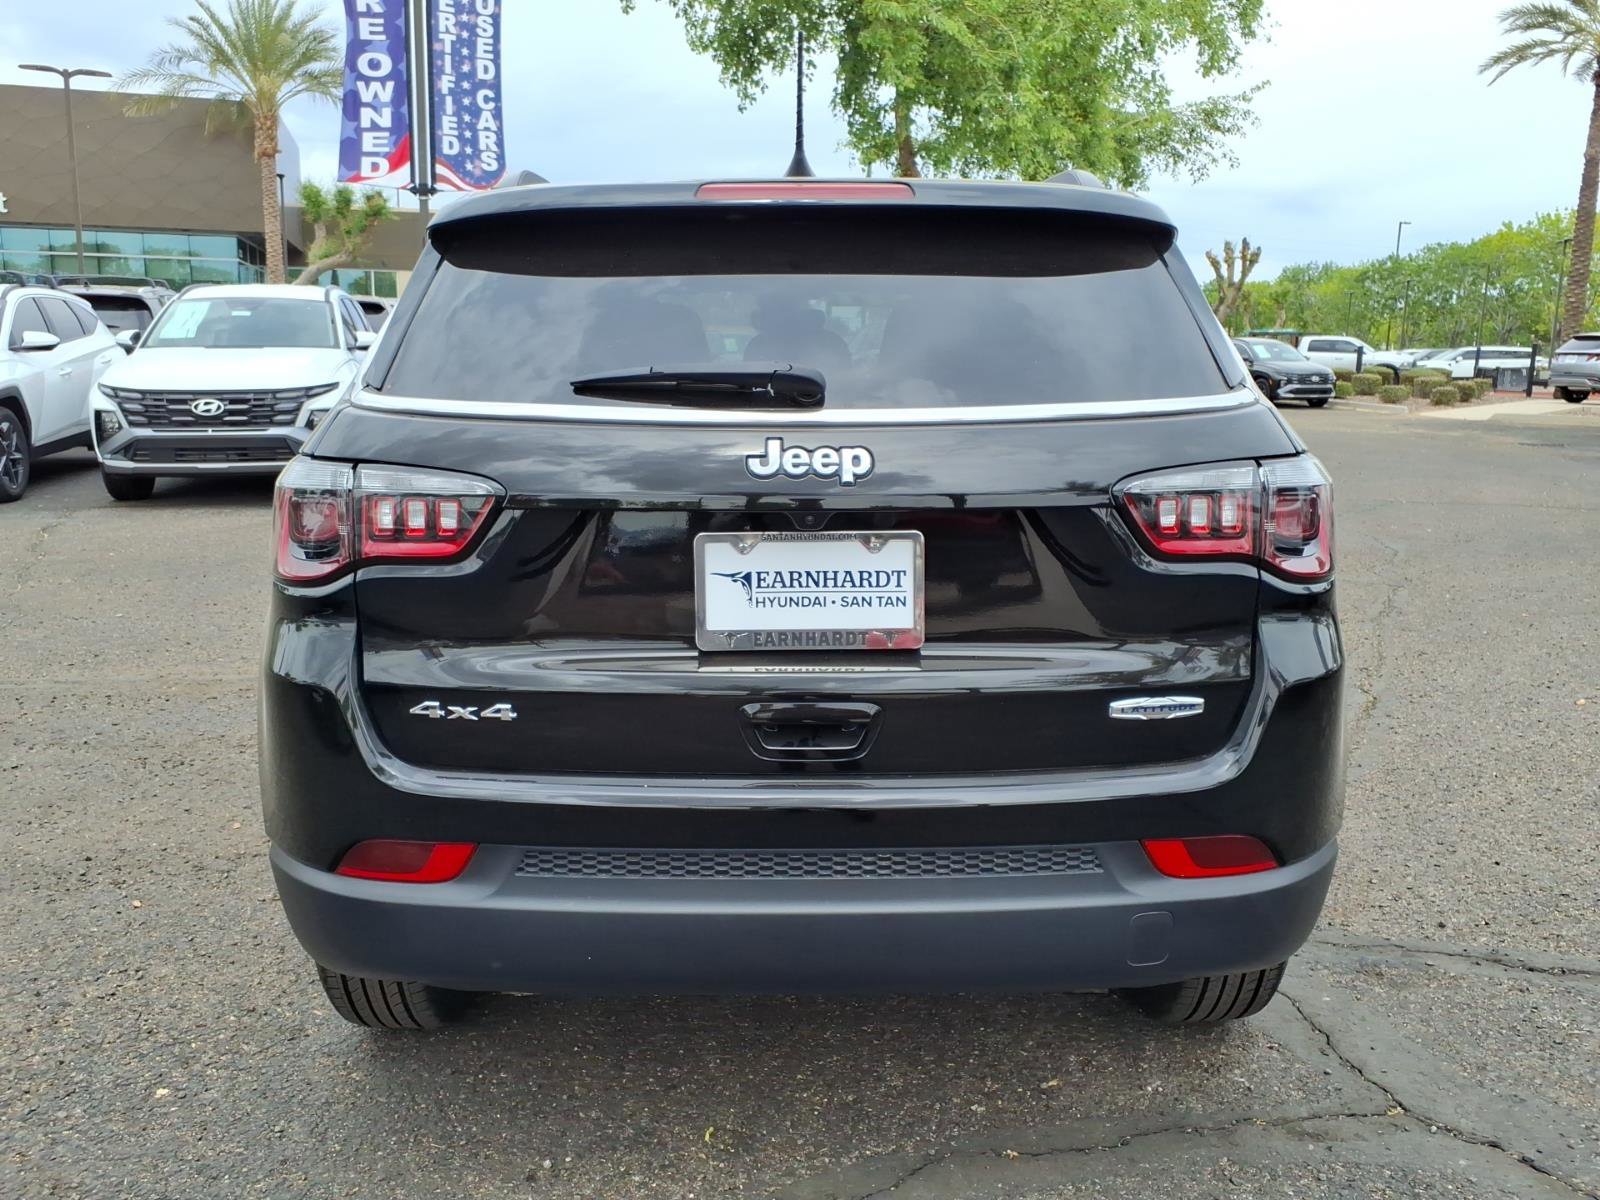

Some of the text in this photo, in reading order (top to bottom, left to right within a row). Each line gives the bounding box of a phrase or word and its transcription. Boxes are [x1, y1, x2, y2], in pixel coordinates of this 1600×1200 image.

[475, 0, 499, 171] USED CARS
[356, 52, 395, 178] OWNED
[745, 437, 874, 486] Jeep
[755, 570, 907, 589] EARNHARDT
[755, 596, 907, 608] HYUNDAI SAN TAN
[753, 631, 868, 647] EARNHARDT
[409, 701, 517, 721] 4x4
